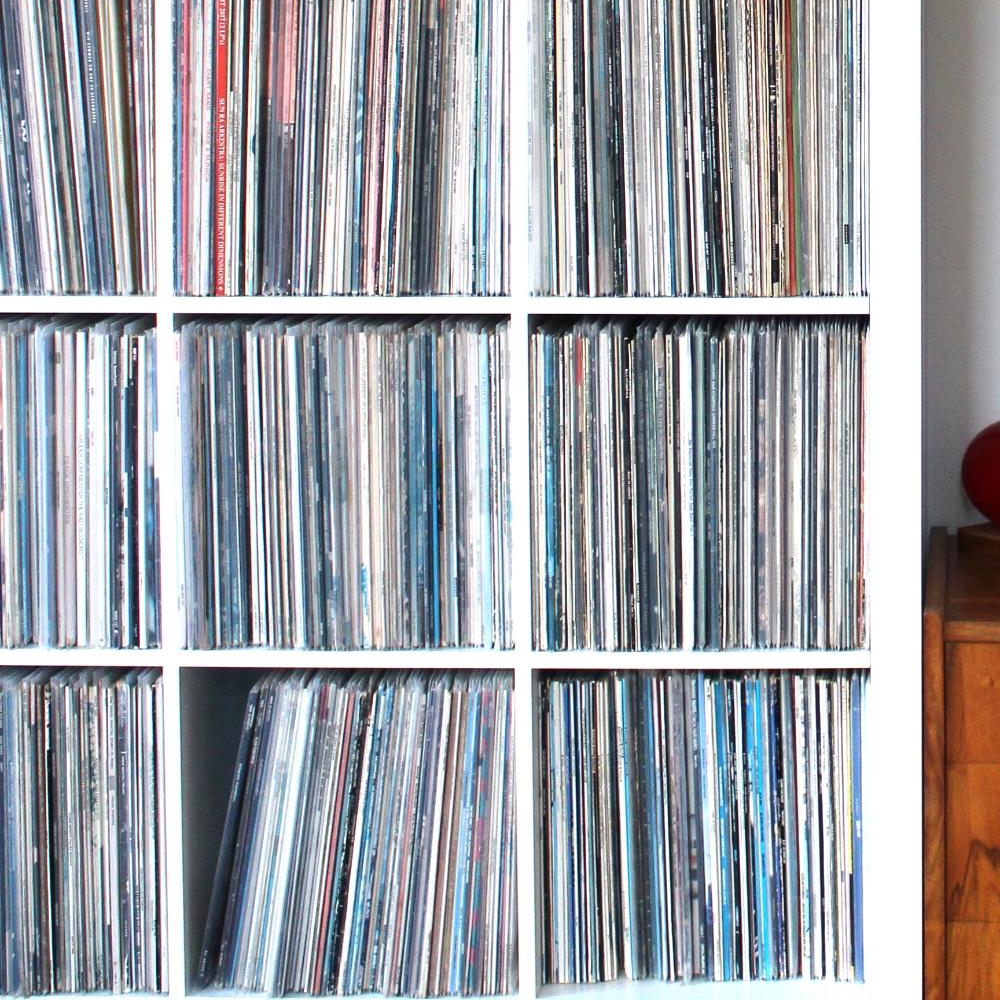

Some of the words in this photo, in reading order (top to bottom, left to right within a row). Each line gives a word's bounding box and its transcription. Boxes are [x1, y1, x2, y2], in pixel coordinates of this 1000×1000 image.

[218, 98, 226, 112] SUN
[218, 113, 225, 123] RA
[218, 193, 225, 201] IN
[217, 241, 225, 285] DIMENSIONS
